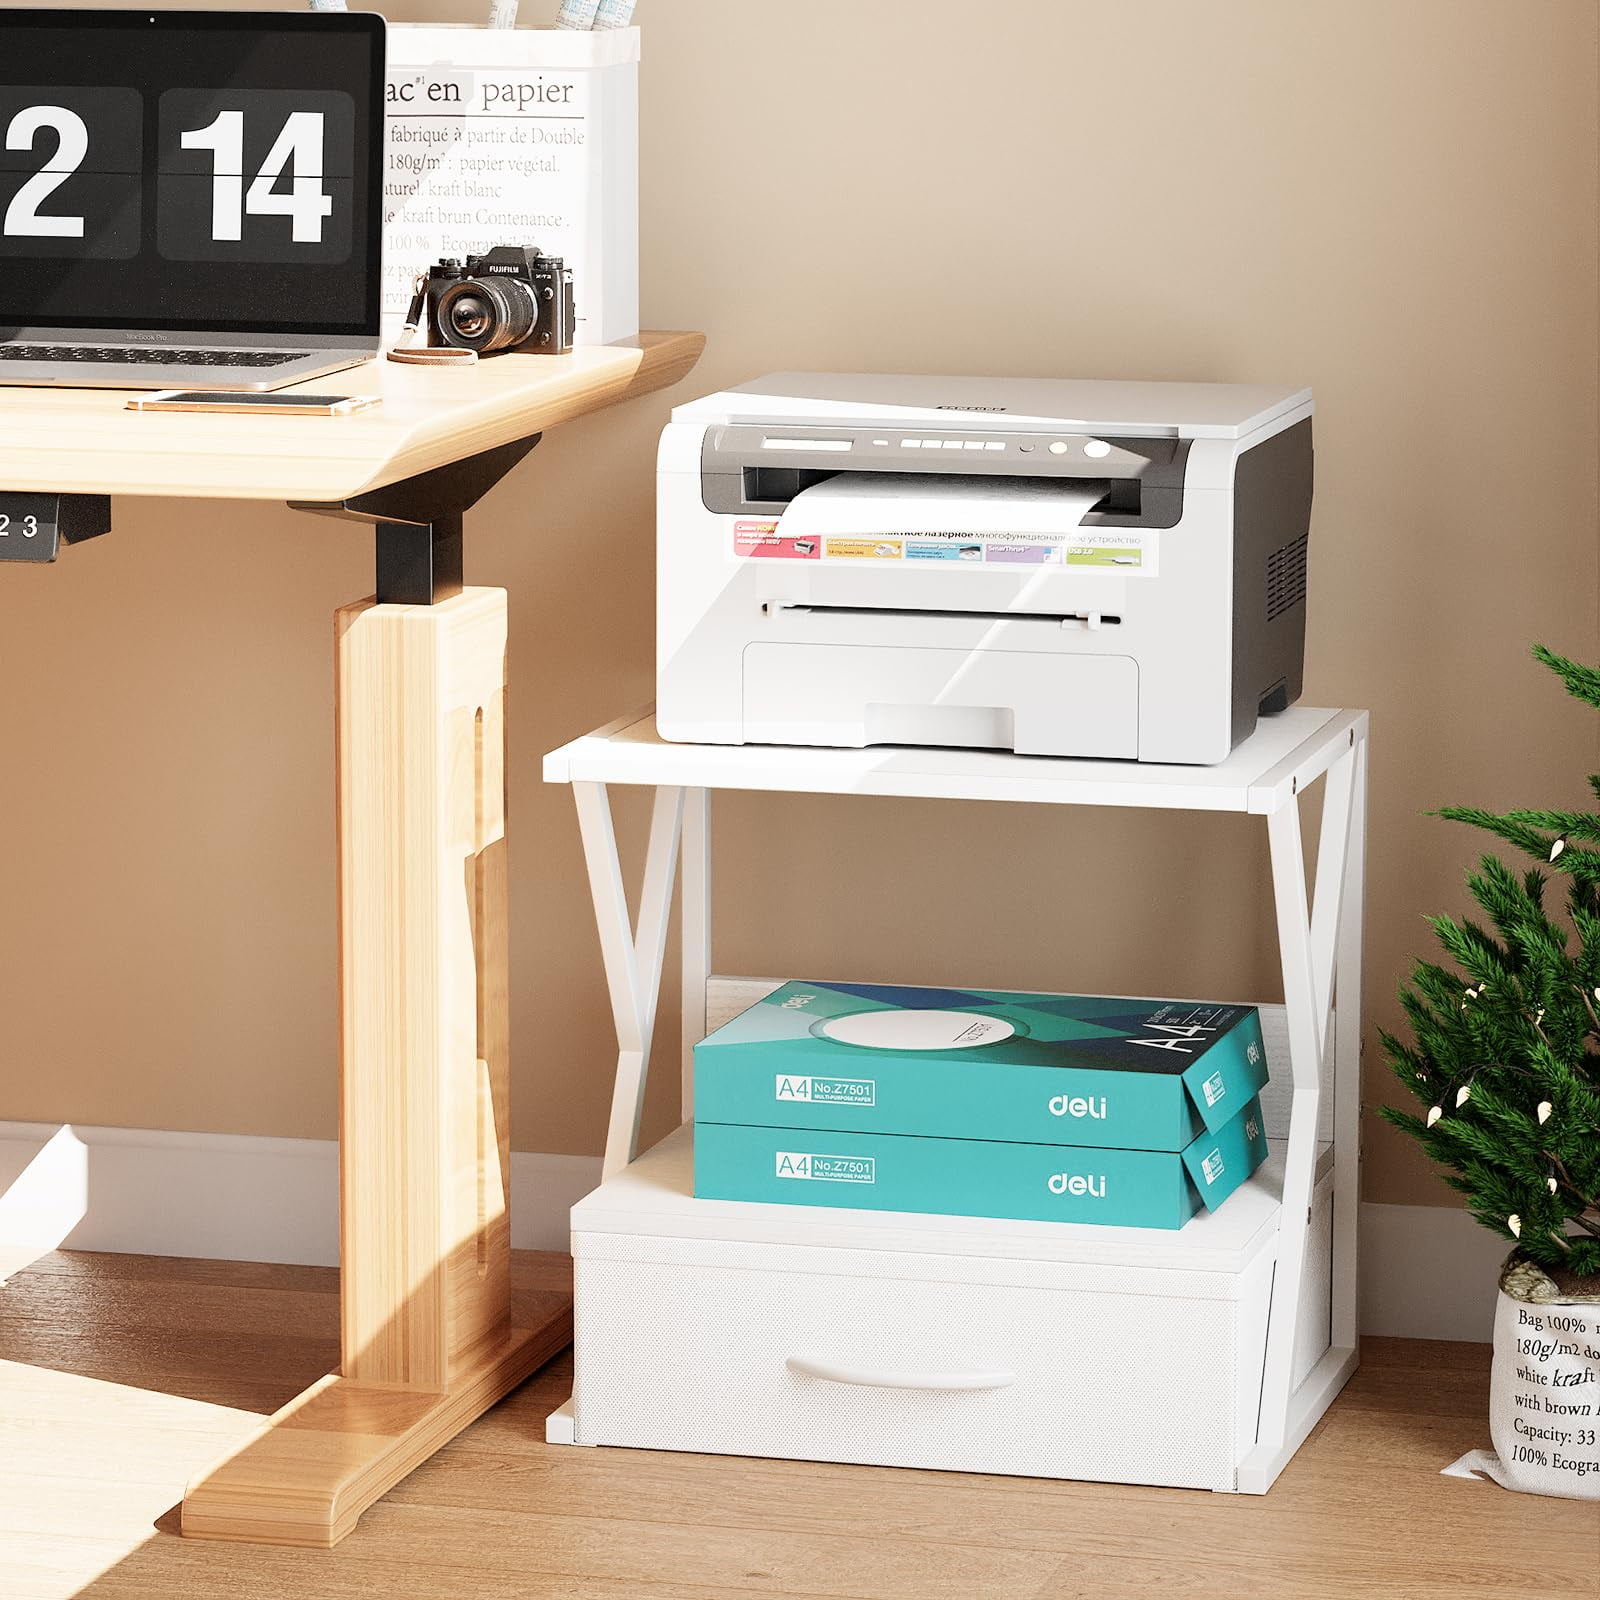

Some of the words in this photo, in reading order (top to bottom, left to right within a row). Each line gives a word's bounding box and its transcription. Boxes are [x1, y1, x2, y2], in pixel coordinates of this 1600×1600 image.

[427, 83, 462, 102] en
[481, 76, 574, 112] papier
[391, 125, 448, 147] fabriqué
[454, 127, 462, 142] à
[467, 126, 506, 148] partir
[509, 126, 527, 144] de
[532, 127, 585, 145] Double
[3, 105, 89, 238] 2
[180, 110, 333, 243] 14
[459, 154, 504, 176] papier
[428, 180, 460, 197] kraft
[464, 180, 502, 198] blanc
[402, 206, 434, 223] kraft
[438, 206, 472, 224] brun
[475, 208, 562, 228] Contenance
[489, 265, 519, 273] FUJIFILM
[22, 515, 38, 538] 3
[1125, 1023, 1217, 1053] A4
[779, 1078, 809, 1098] A4
[814, 1083, 870, 1096] No.Z7501
[1048, 1094, 1107, 1120] deli
[779, 1155, 809, 1175] A4
[814, 1160, 870, 1174] No.Z7501
[1047, 1172, 1106, 1198] deli
[1519, 1309, 1544, 1332] Bag
[1547, 1315, 1586, 1333] 100%
[1517, 1338, 1581, 1362] 180g/m2
[1516, 1366, 1548, 1386] white
[1552, 1367, 1596, 1387] kraft
[1515, 1393, 1541, 1411] with
[1545, 1397, 1591, 1416] brown
[1513, 1417, 1572, 1447] Capacity:
[1577, 1429, 1596, 1446] 33
[1511, 1444, 1547, 1467] 100%
